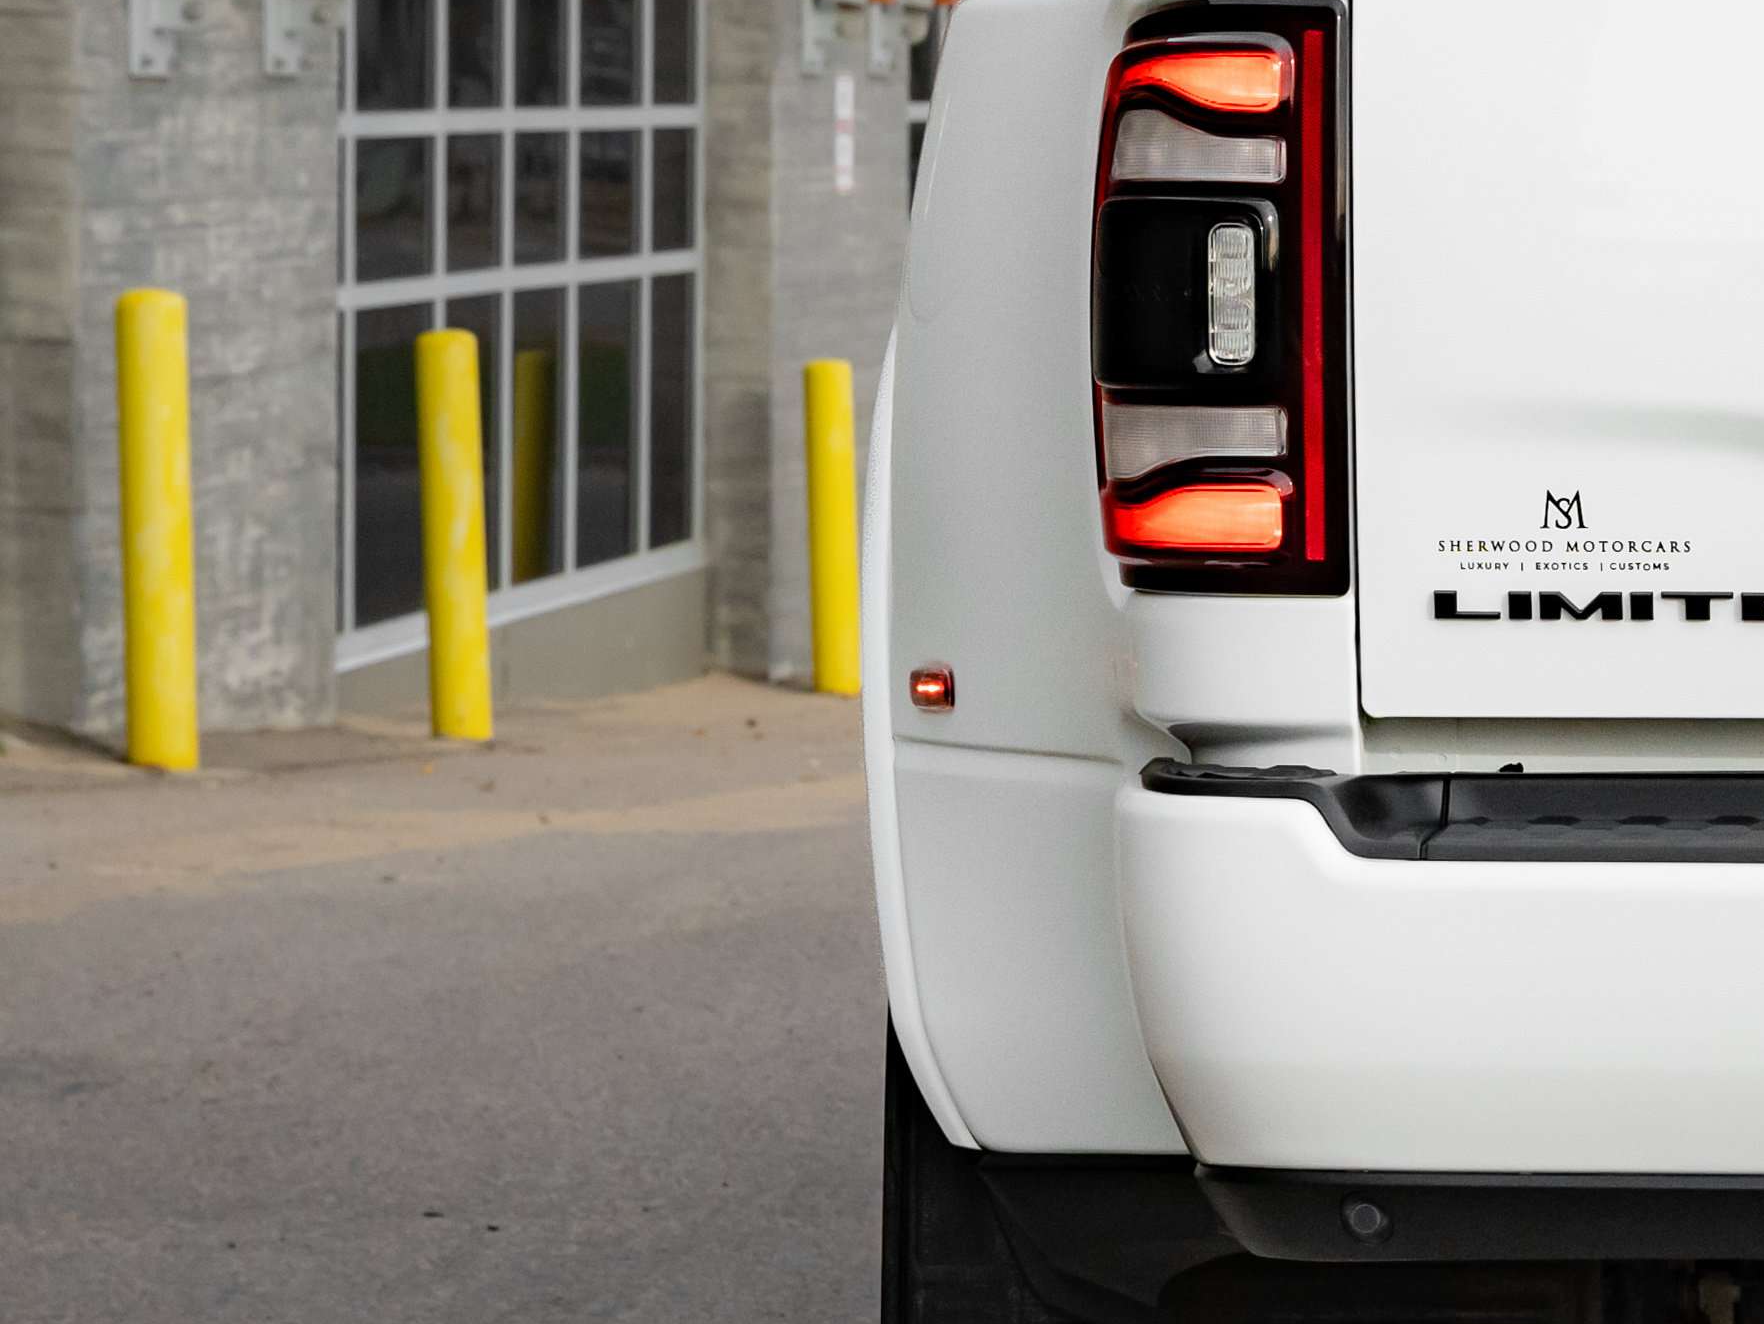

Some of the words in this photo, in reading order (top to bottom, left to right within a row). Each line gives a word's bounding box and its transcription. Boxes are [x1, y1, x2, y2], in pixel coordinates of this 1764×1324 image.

[1438, 540, 1553, 553] SHERWOOD
[1565, 540, 1691, 553] MOTORCARS
[1459, 562, 1510, 571] LUXURY
[1535, 562, 1589, 571] EXOTICS
[1609, 562, 1670, 571] CUSTOMS
